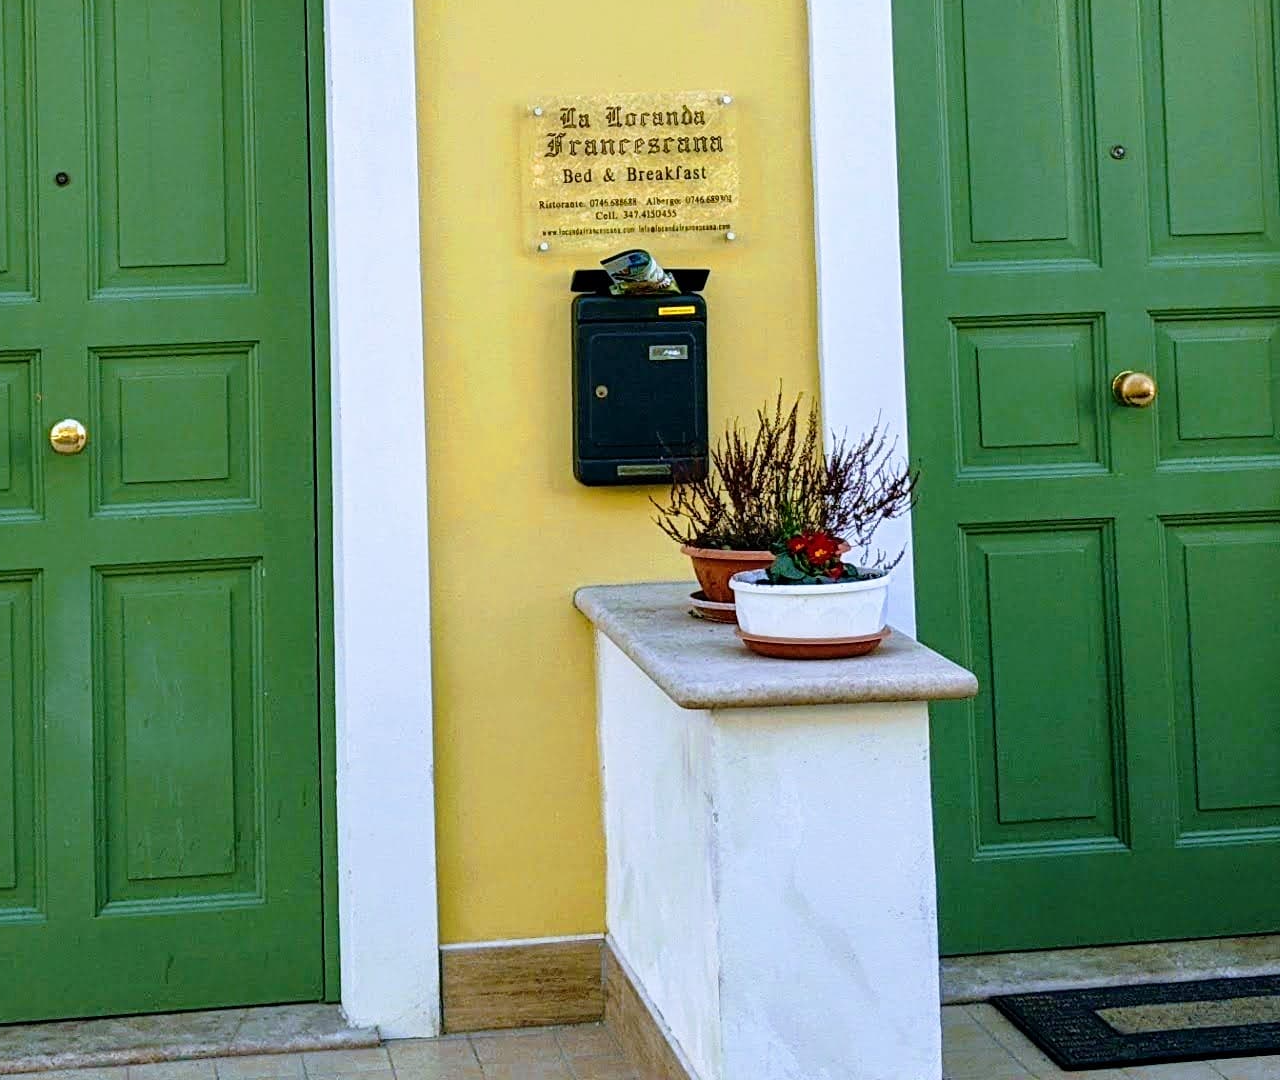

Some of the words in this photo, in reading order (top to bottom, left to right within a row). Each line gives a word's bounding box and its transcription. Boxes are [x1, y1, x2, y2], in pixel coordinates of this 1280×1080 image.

[560, 107, 591, 129] La
[605, 104, 706, 128] Locanda
[544, 132, 724, 158] Francescana
[563, 168, 592, 183] Bed
[603, 168, 615, 182] &
[627, 166, 707, 182] Breakfast
[595, 210, 618, 220] Cell.
